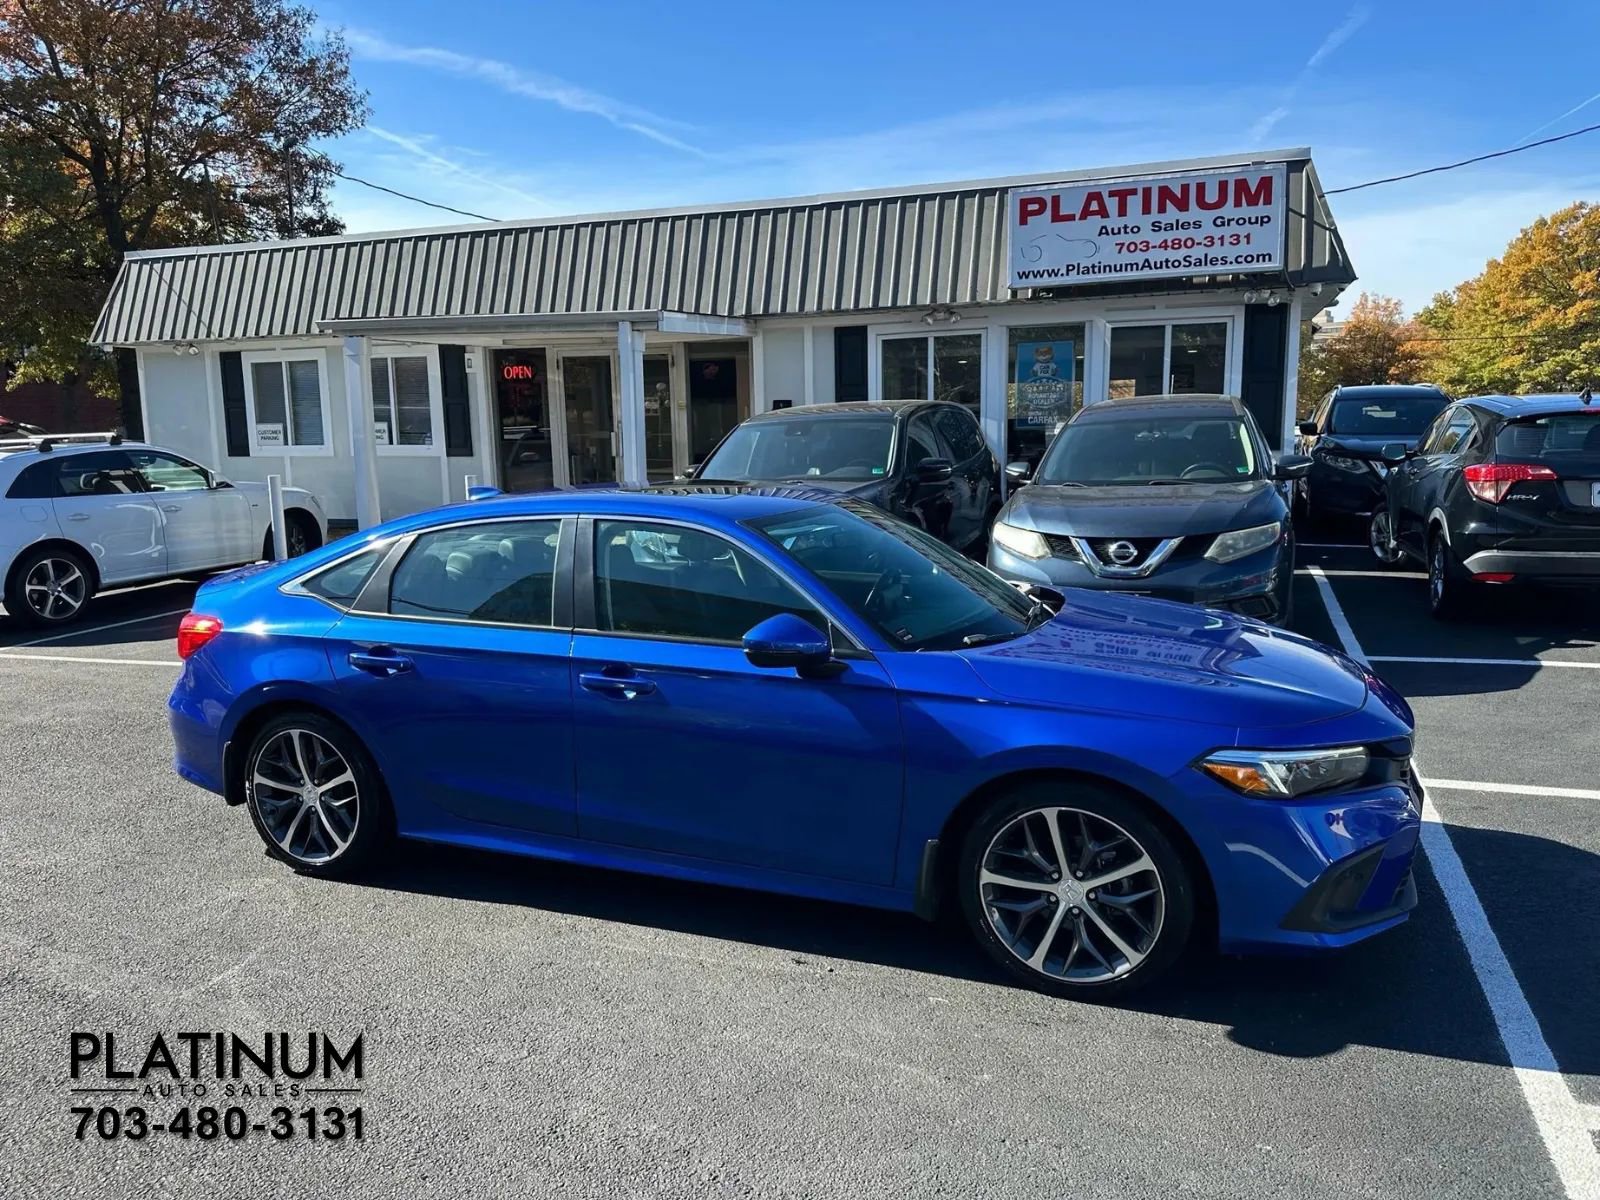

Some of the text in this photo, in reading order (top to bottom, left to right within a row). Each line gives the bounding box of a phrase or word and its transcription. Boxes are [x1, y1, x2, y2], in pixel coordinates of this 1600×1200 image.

[1018, 176, 1274, 226] PLATINUM
[1097, 214, 1272, 237] Auto Sales Group
[1114, 232, 1252, 255] 703-480-3131
[1016, 251, 1273, 280] www.PlatinumAutoSales.com
[503, 365, 533, 380] OPEN
[1027, 415, 1059, 425] CARFAX
